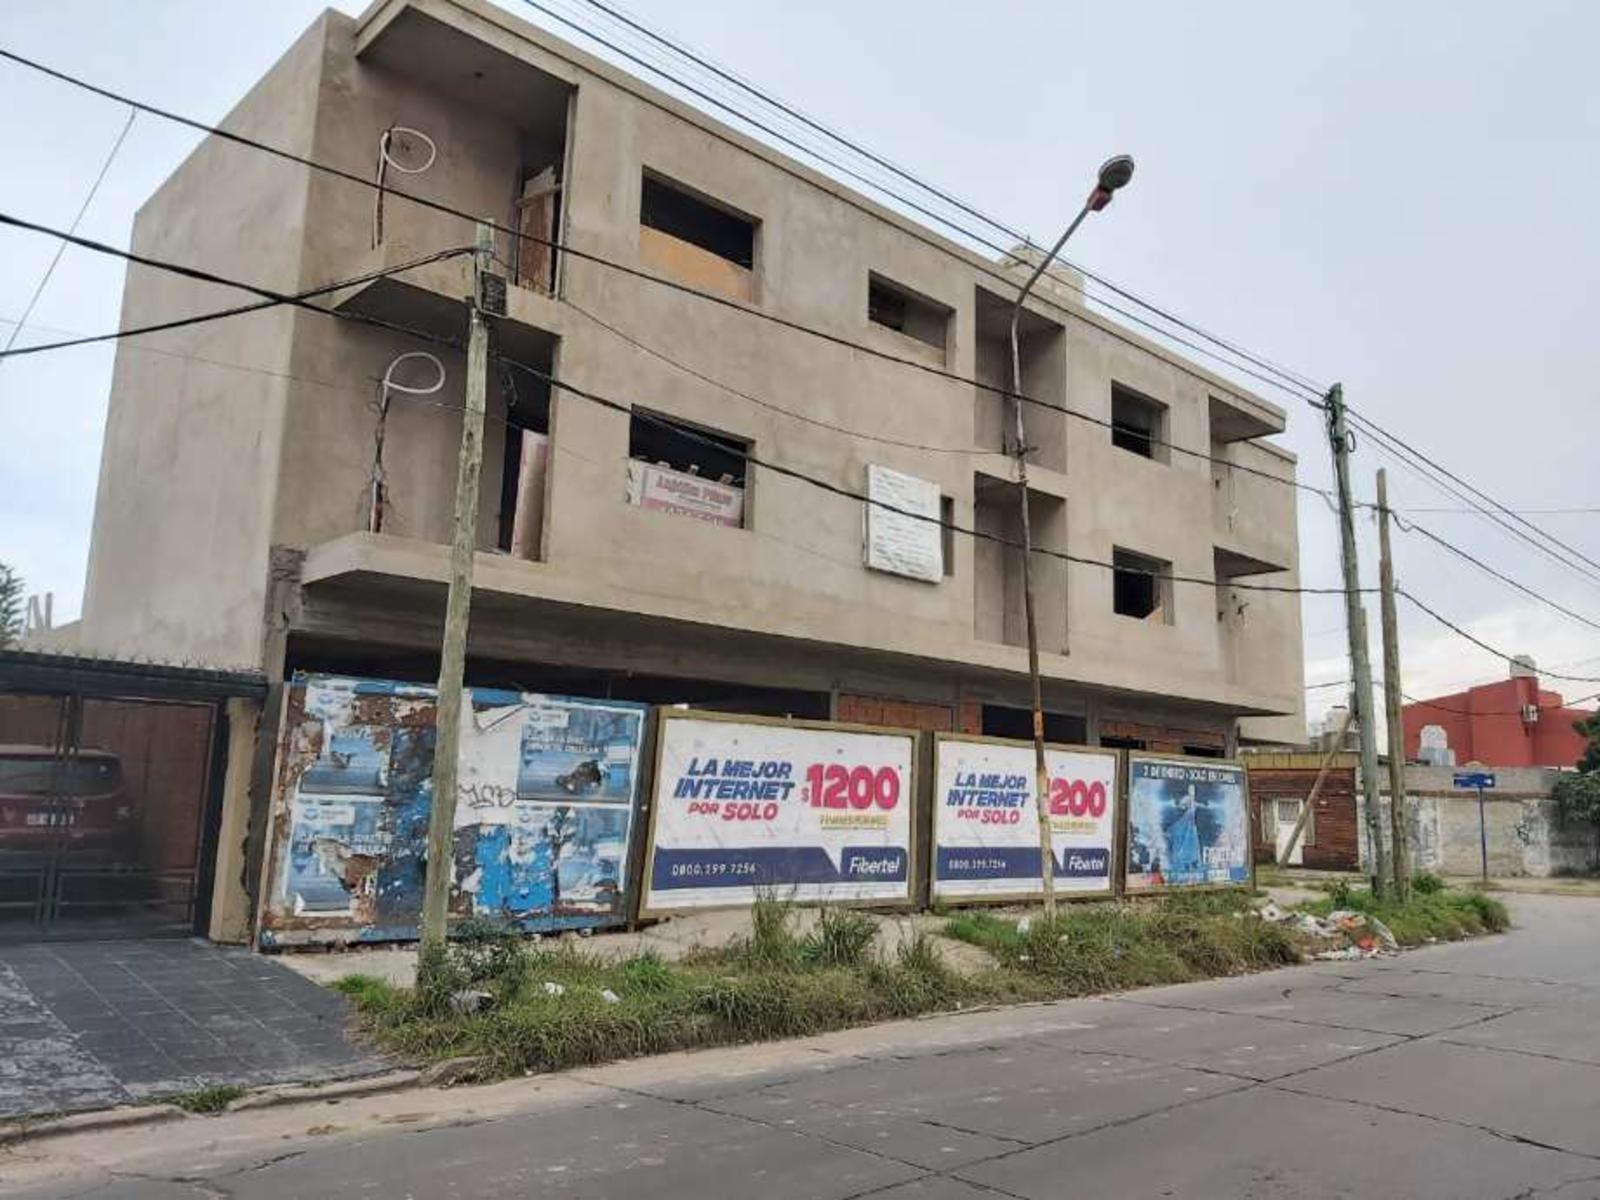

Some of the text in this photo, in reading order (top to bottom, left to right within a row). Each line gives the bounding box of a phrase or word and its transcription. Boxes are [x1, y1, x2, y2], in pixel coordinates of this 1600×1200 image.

[687, 757, 793, 779] LA MEJOR
[674, 778, 795, 800] INTERNET
[955, 772, 1027, 789] LA MEJOR
[946, 789, 1029, 808] INTERNET
[688, 801, 779, 821] POR SOLO
[981, 810, 1020, 825] SOLO
[848, 855, 901, 874] Fibertel
